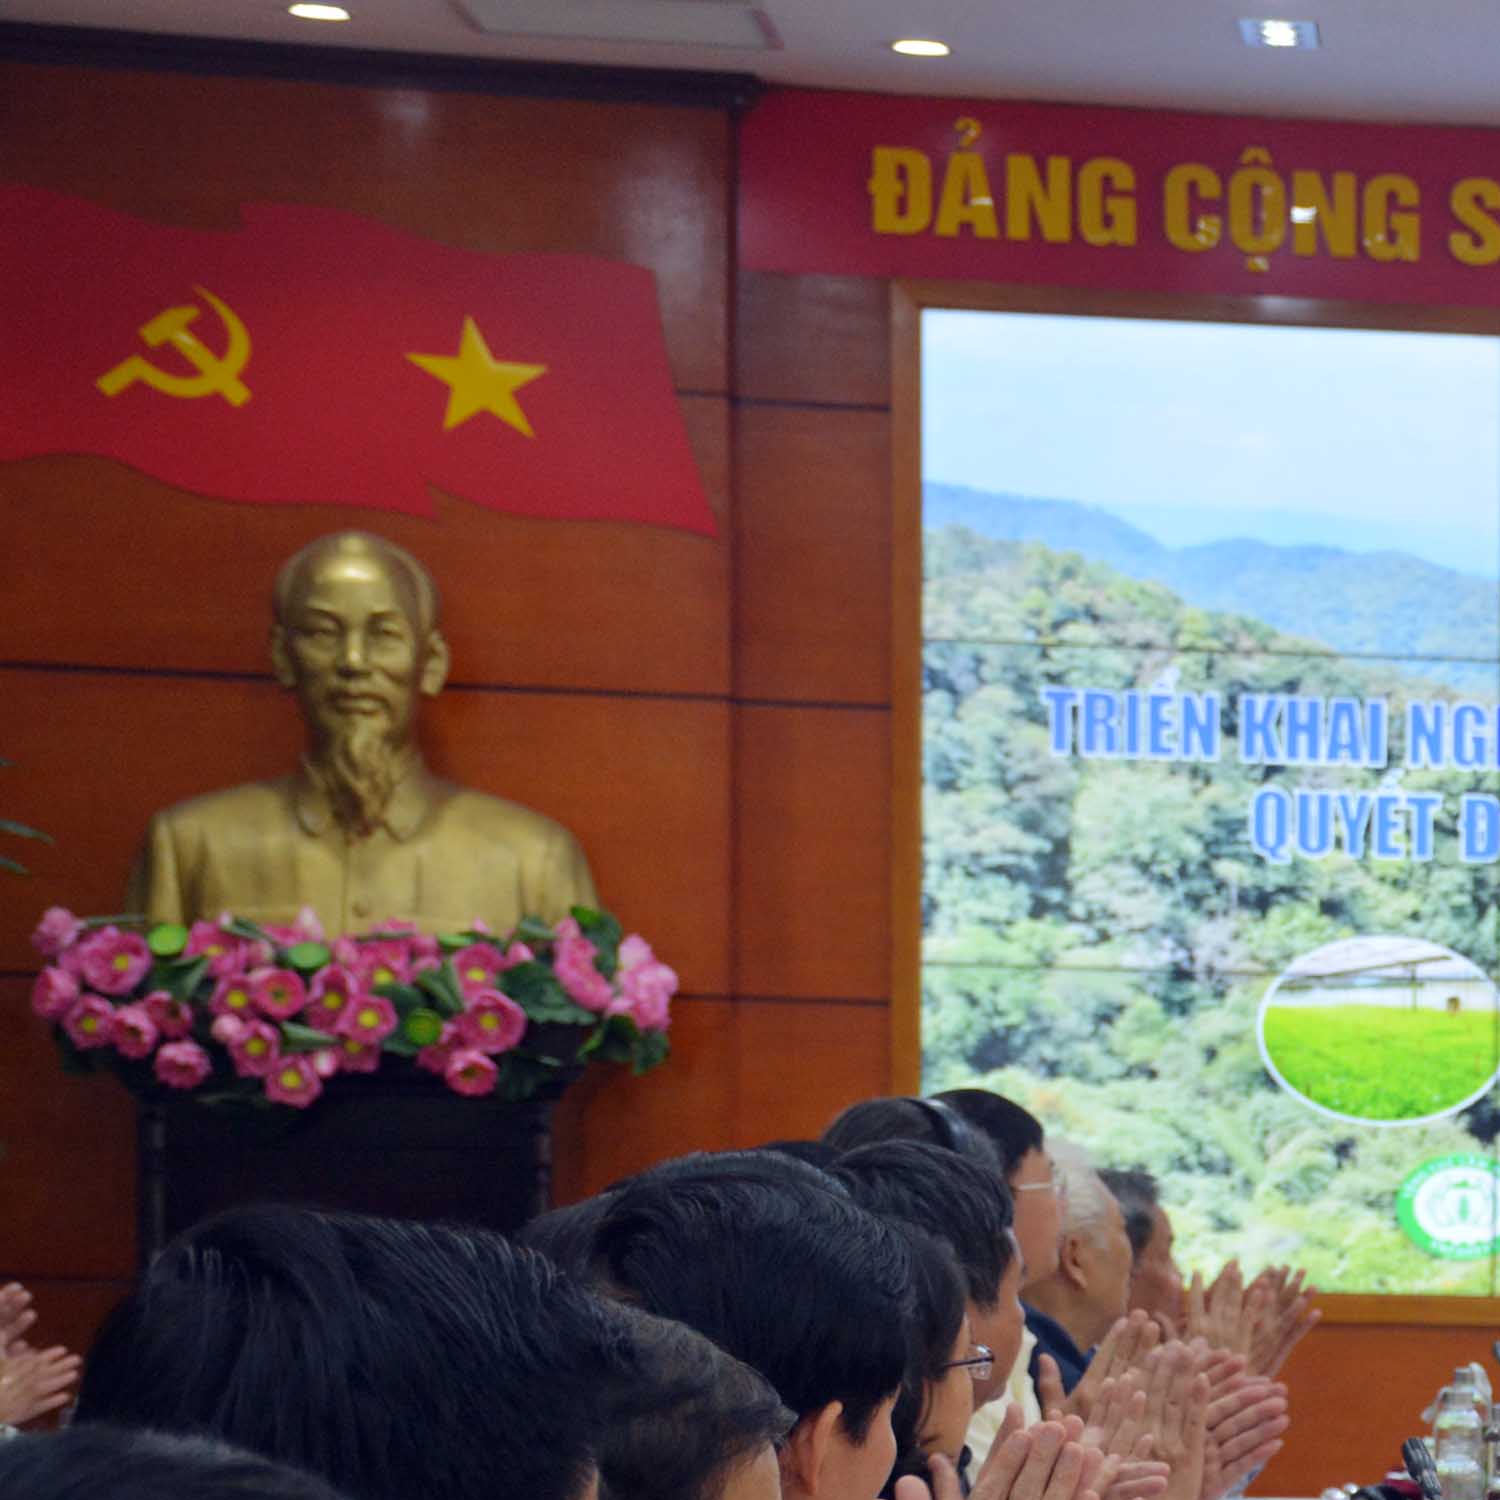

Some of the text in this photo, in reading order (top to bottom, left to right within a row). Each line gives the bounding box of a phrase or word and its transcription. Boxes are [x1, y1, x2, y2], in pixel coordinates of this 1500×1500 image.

[867, 115, 1137, 247] ĐẢNG
[1163, 145, 1421, 272] CỘNG
[1042, 666, 1219, 756] TRIỂN
[1241, 692, 1388, 763] KHAI
[1253, 770, 1440, 864] QUYẾT
